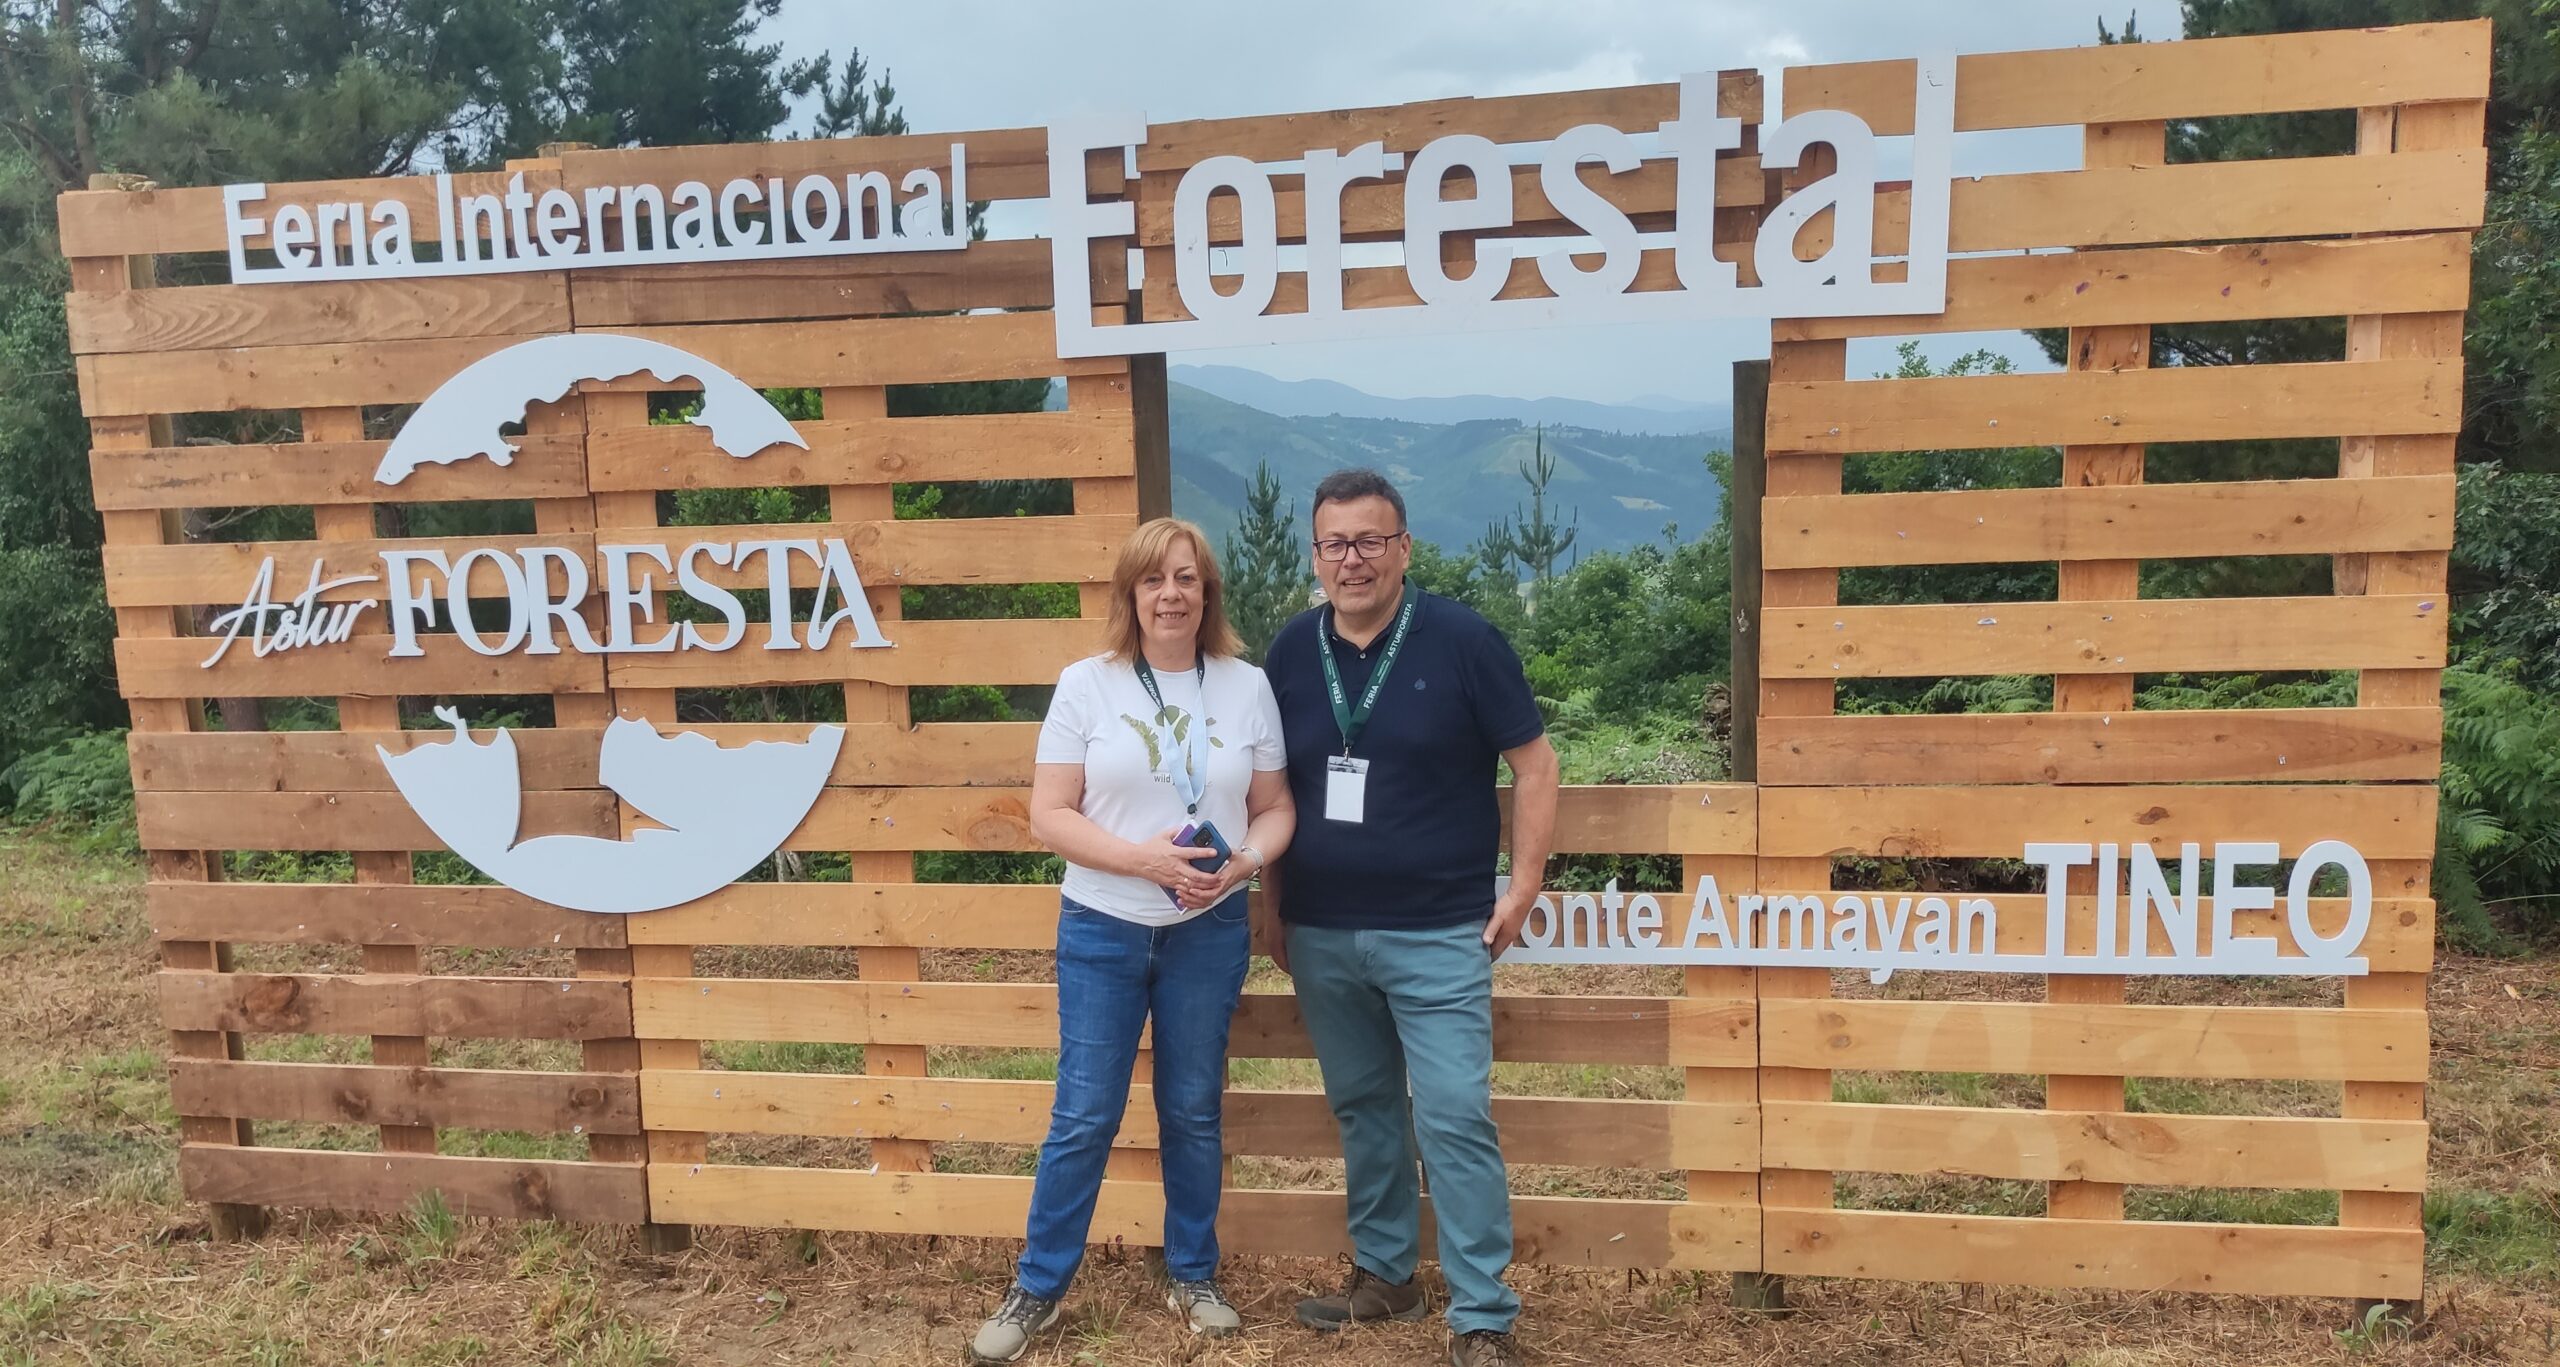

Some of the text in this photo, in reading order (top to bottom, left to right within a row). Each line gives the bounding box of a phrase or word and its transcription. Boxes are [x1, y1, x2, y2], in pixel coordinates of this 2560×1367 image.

[223, 142, 968, 285] Feria Internacional
[1047, 48, 1956, 358] Forestal
[201, 538, 895, 669] Astur FORESTA
[1363, 603, 1413, 709] FERIA ASTURFORESTA
[1331, 680, 1343, 704] FERIA
[1153, 774, 1171, 783] wild
[1494, 840, 2372, 984] onte Armayan TINEO
